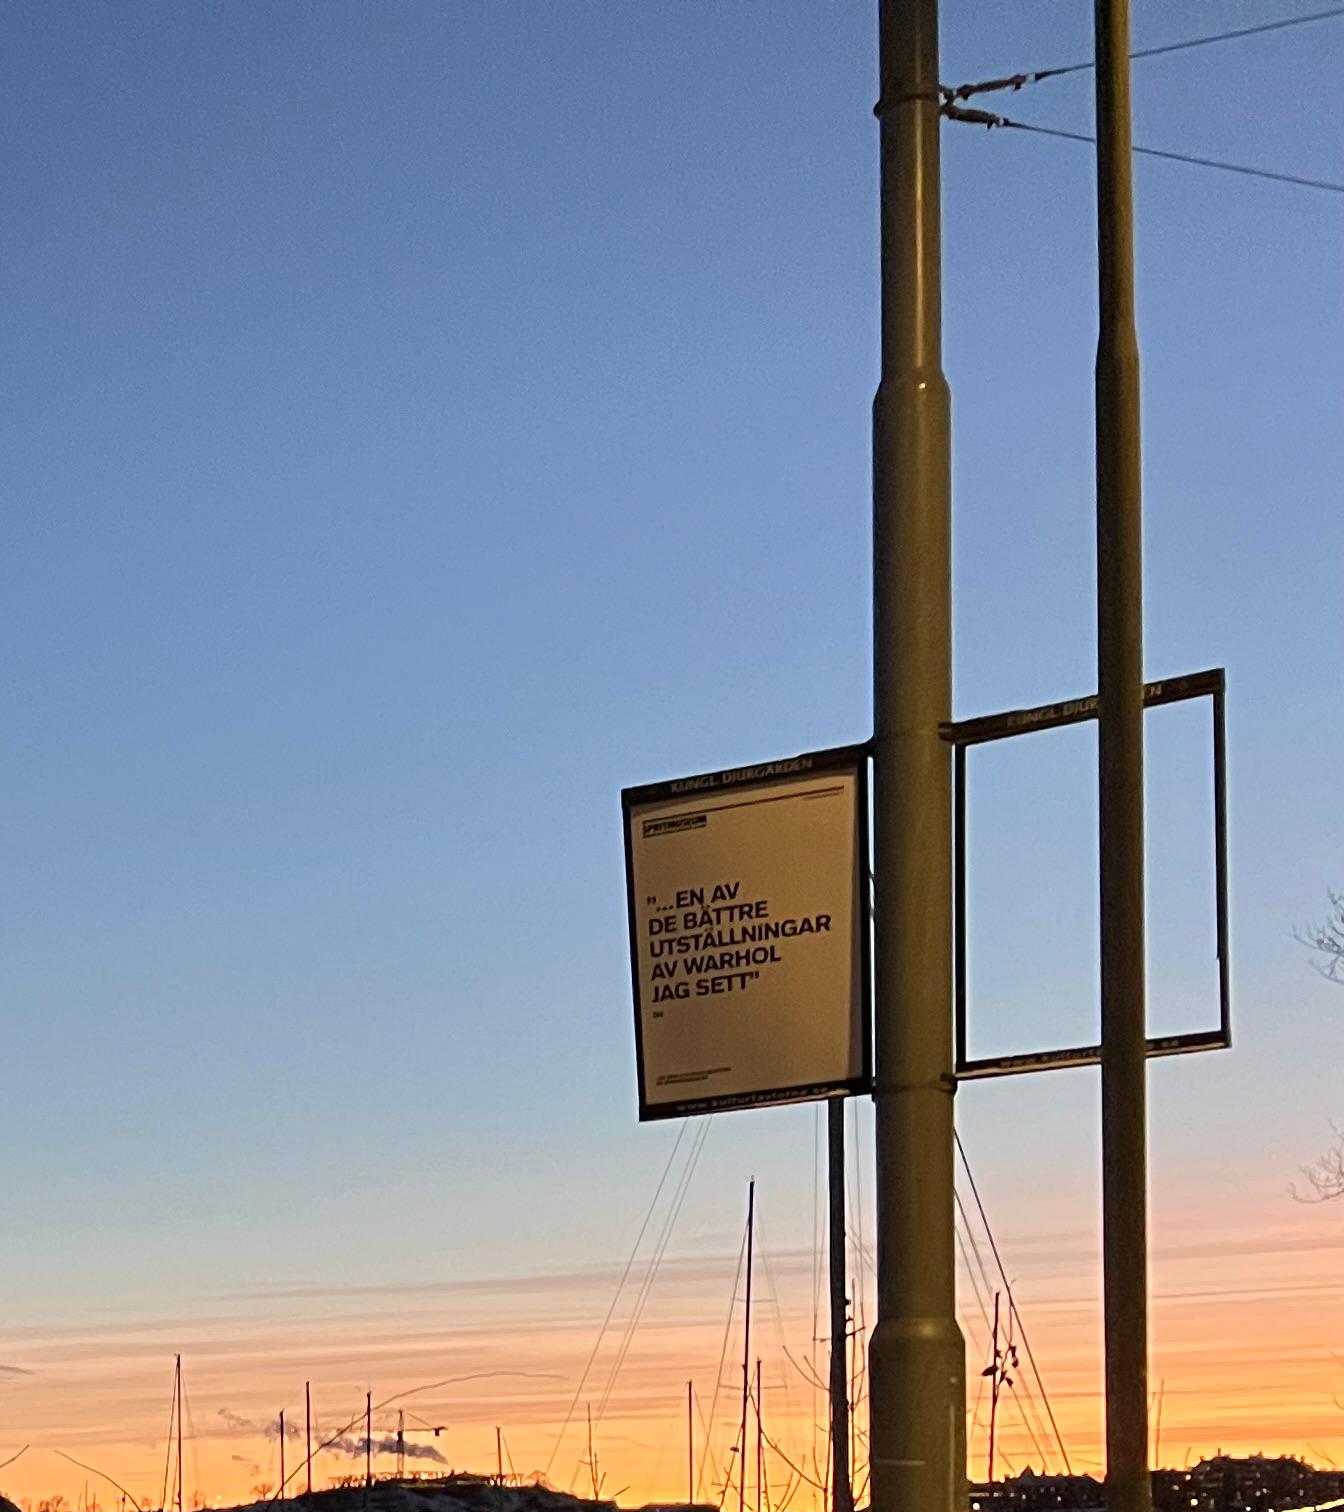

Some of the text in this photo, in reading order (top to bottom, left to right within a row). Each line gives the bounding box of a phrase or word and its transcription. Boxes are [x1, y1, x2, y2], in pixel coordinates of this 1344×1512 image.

[711, 881, 740, 903] AV
[649, 900, 769, 936] DE BÄTTRE
[650, 914, 832, 958] UTSTÄLLNINGAR
[651, 945, 782, 981] AV WARHOL
[652, 982, 690, 1003] JAG
